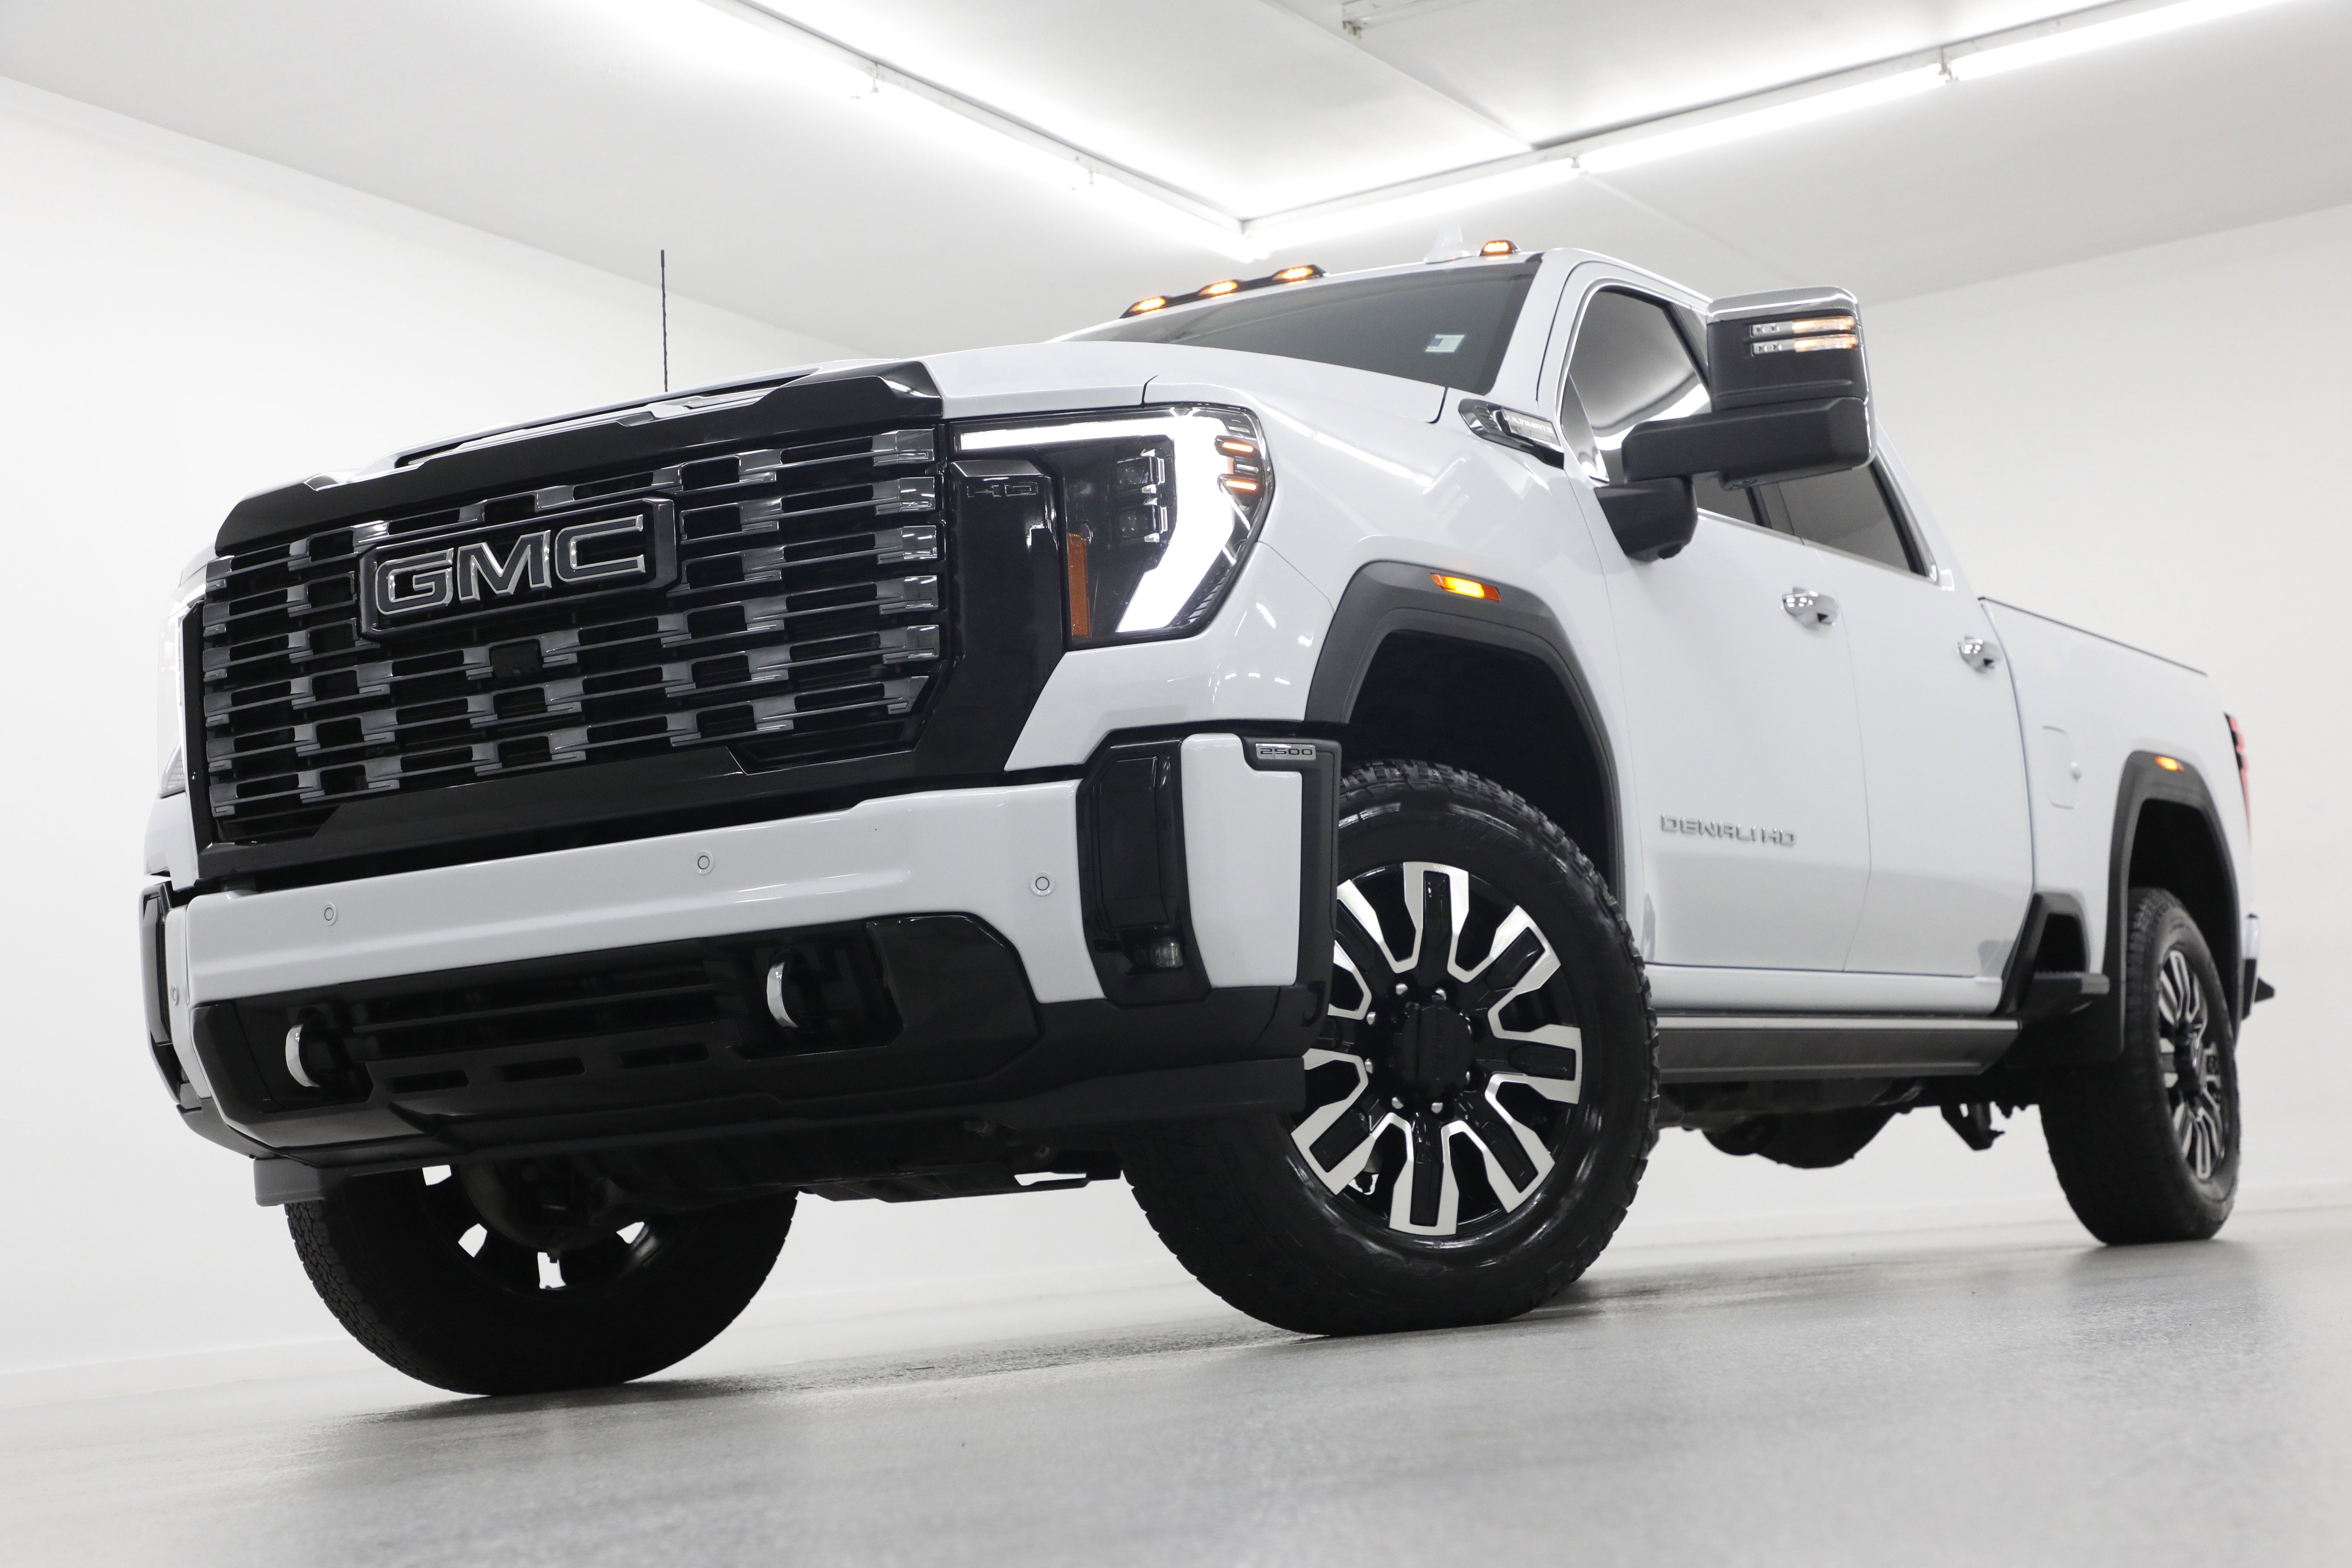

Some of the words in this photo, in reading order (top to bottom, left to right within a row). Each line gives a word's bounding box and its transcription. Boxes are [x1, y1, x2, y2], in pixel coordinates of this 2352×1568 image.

[1506, 415, 1554, 434] ULTIMATE
[967, 482, 1038, 497] HD
[375, 514, 646, 615] GMC
[1661, 814, 1757, 842] DENALI
[1762, 826, 1795, 846] HD
